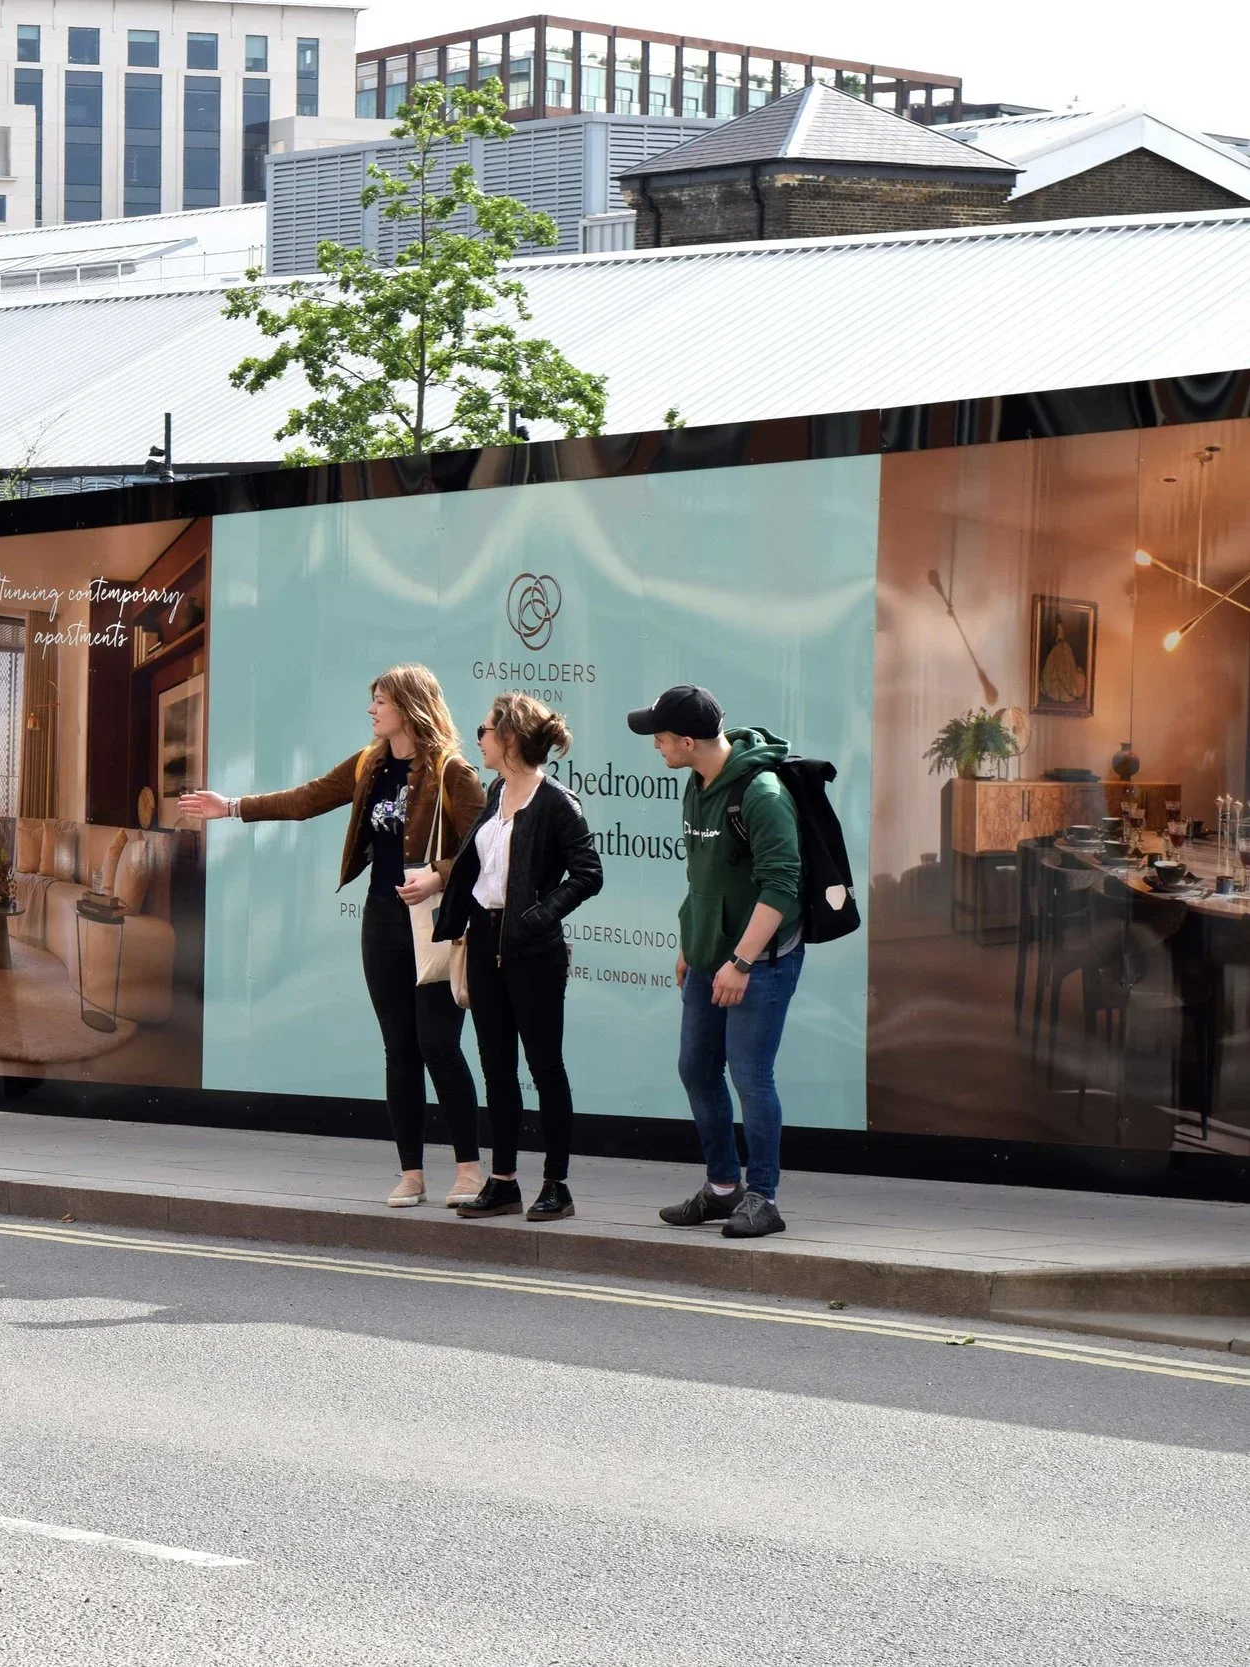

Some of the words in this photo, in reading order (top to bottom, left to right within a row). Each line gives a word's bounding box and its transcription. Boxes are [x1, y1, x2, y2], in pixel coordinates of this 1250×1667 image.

[69, 576, 184, 624] contemporary
[34, 620, 128, 659] apartments
[472, 661, 597, 683] GASHOLDERS
[567, 759, 680, 800] bedroom
[592, 821, 687, 861] nthouse
[340, 902, 362, 919] PRI
[562, 923, 678, 949] OLDERSLONDO
[596, 968, 647, 986] LONDON
[651, 974, 673, 988] N1C
